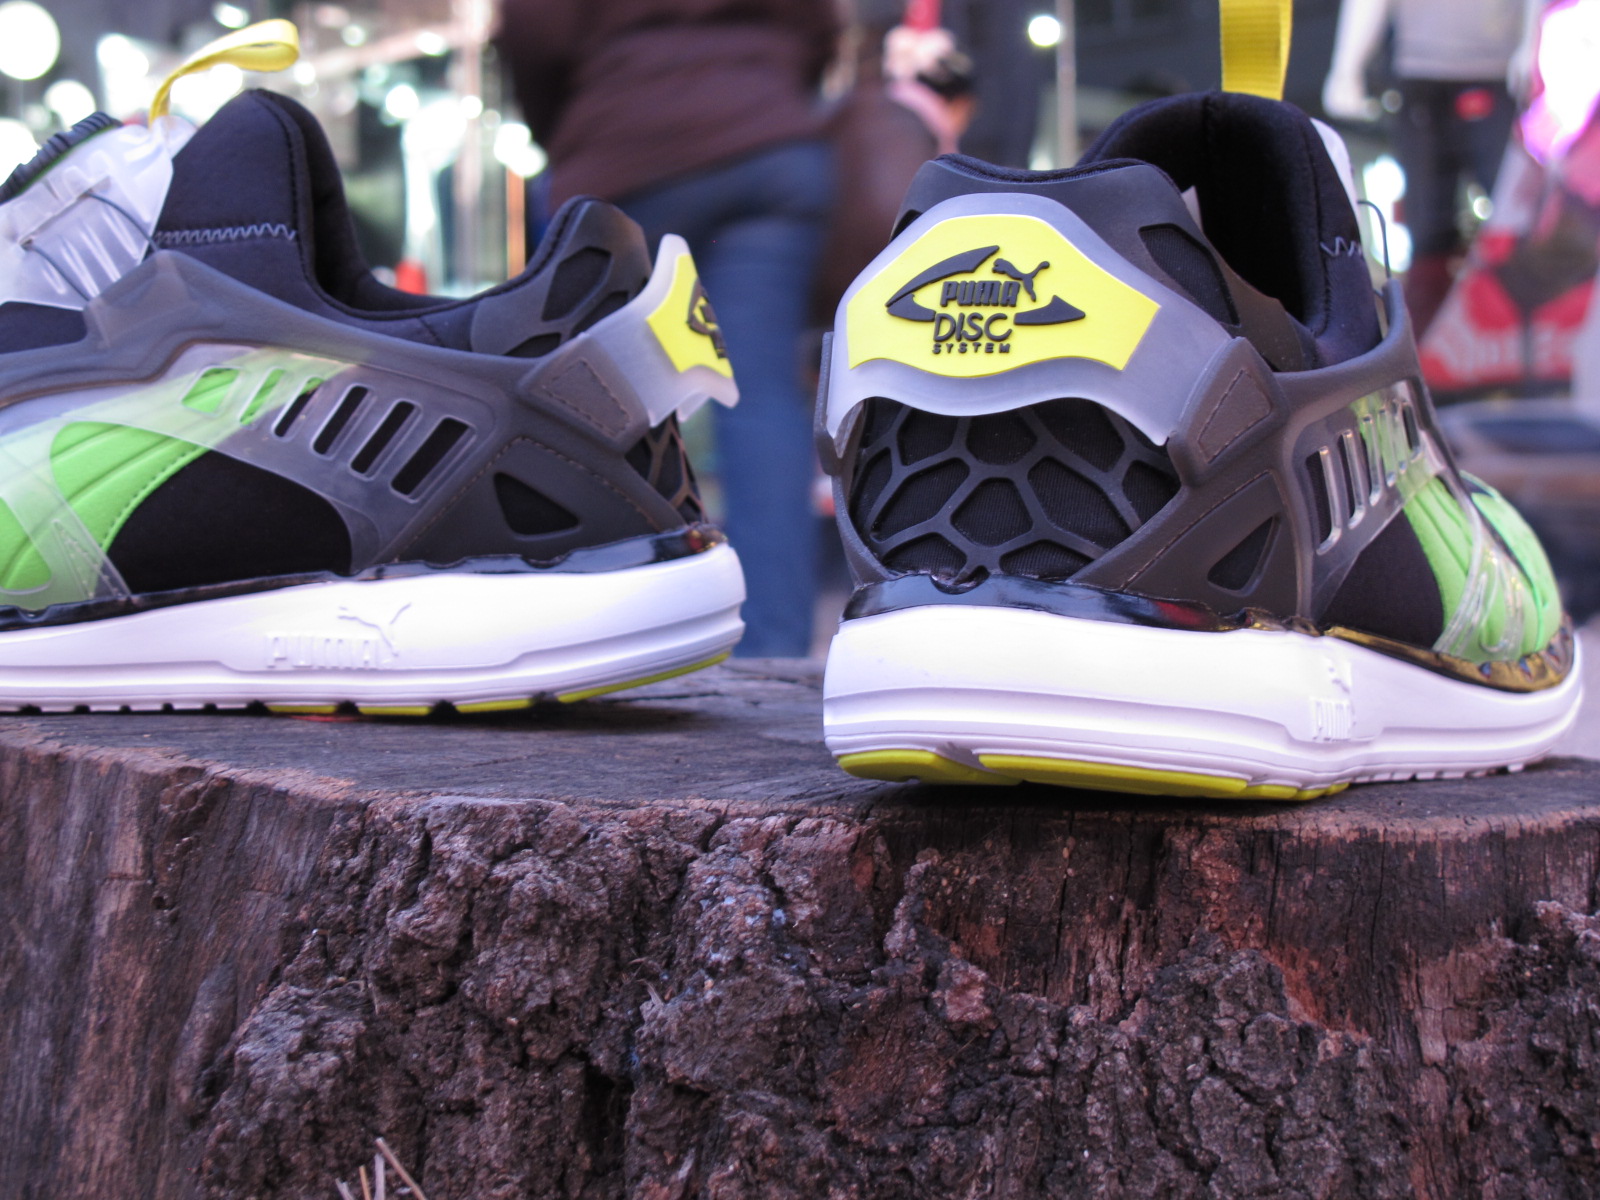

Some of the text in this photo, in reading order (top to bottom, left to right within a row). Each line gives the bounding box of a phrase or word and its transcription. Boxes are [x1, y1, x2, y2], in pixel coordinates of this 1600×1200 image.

[940, 280, 1021, 308] PUMA
[933, 312, 1013, 342] DISC
[932, 342, 1011, 355] SYSTEM
[265, 632, 379, 671] PUMA
